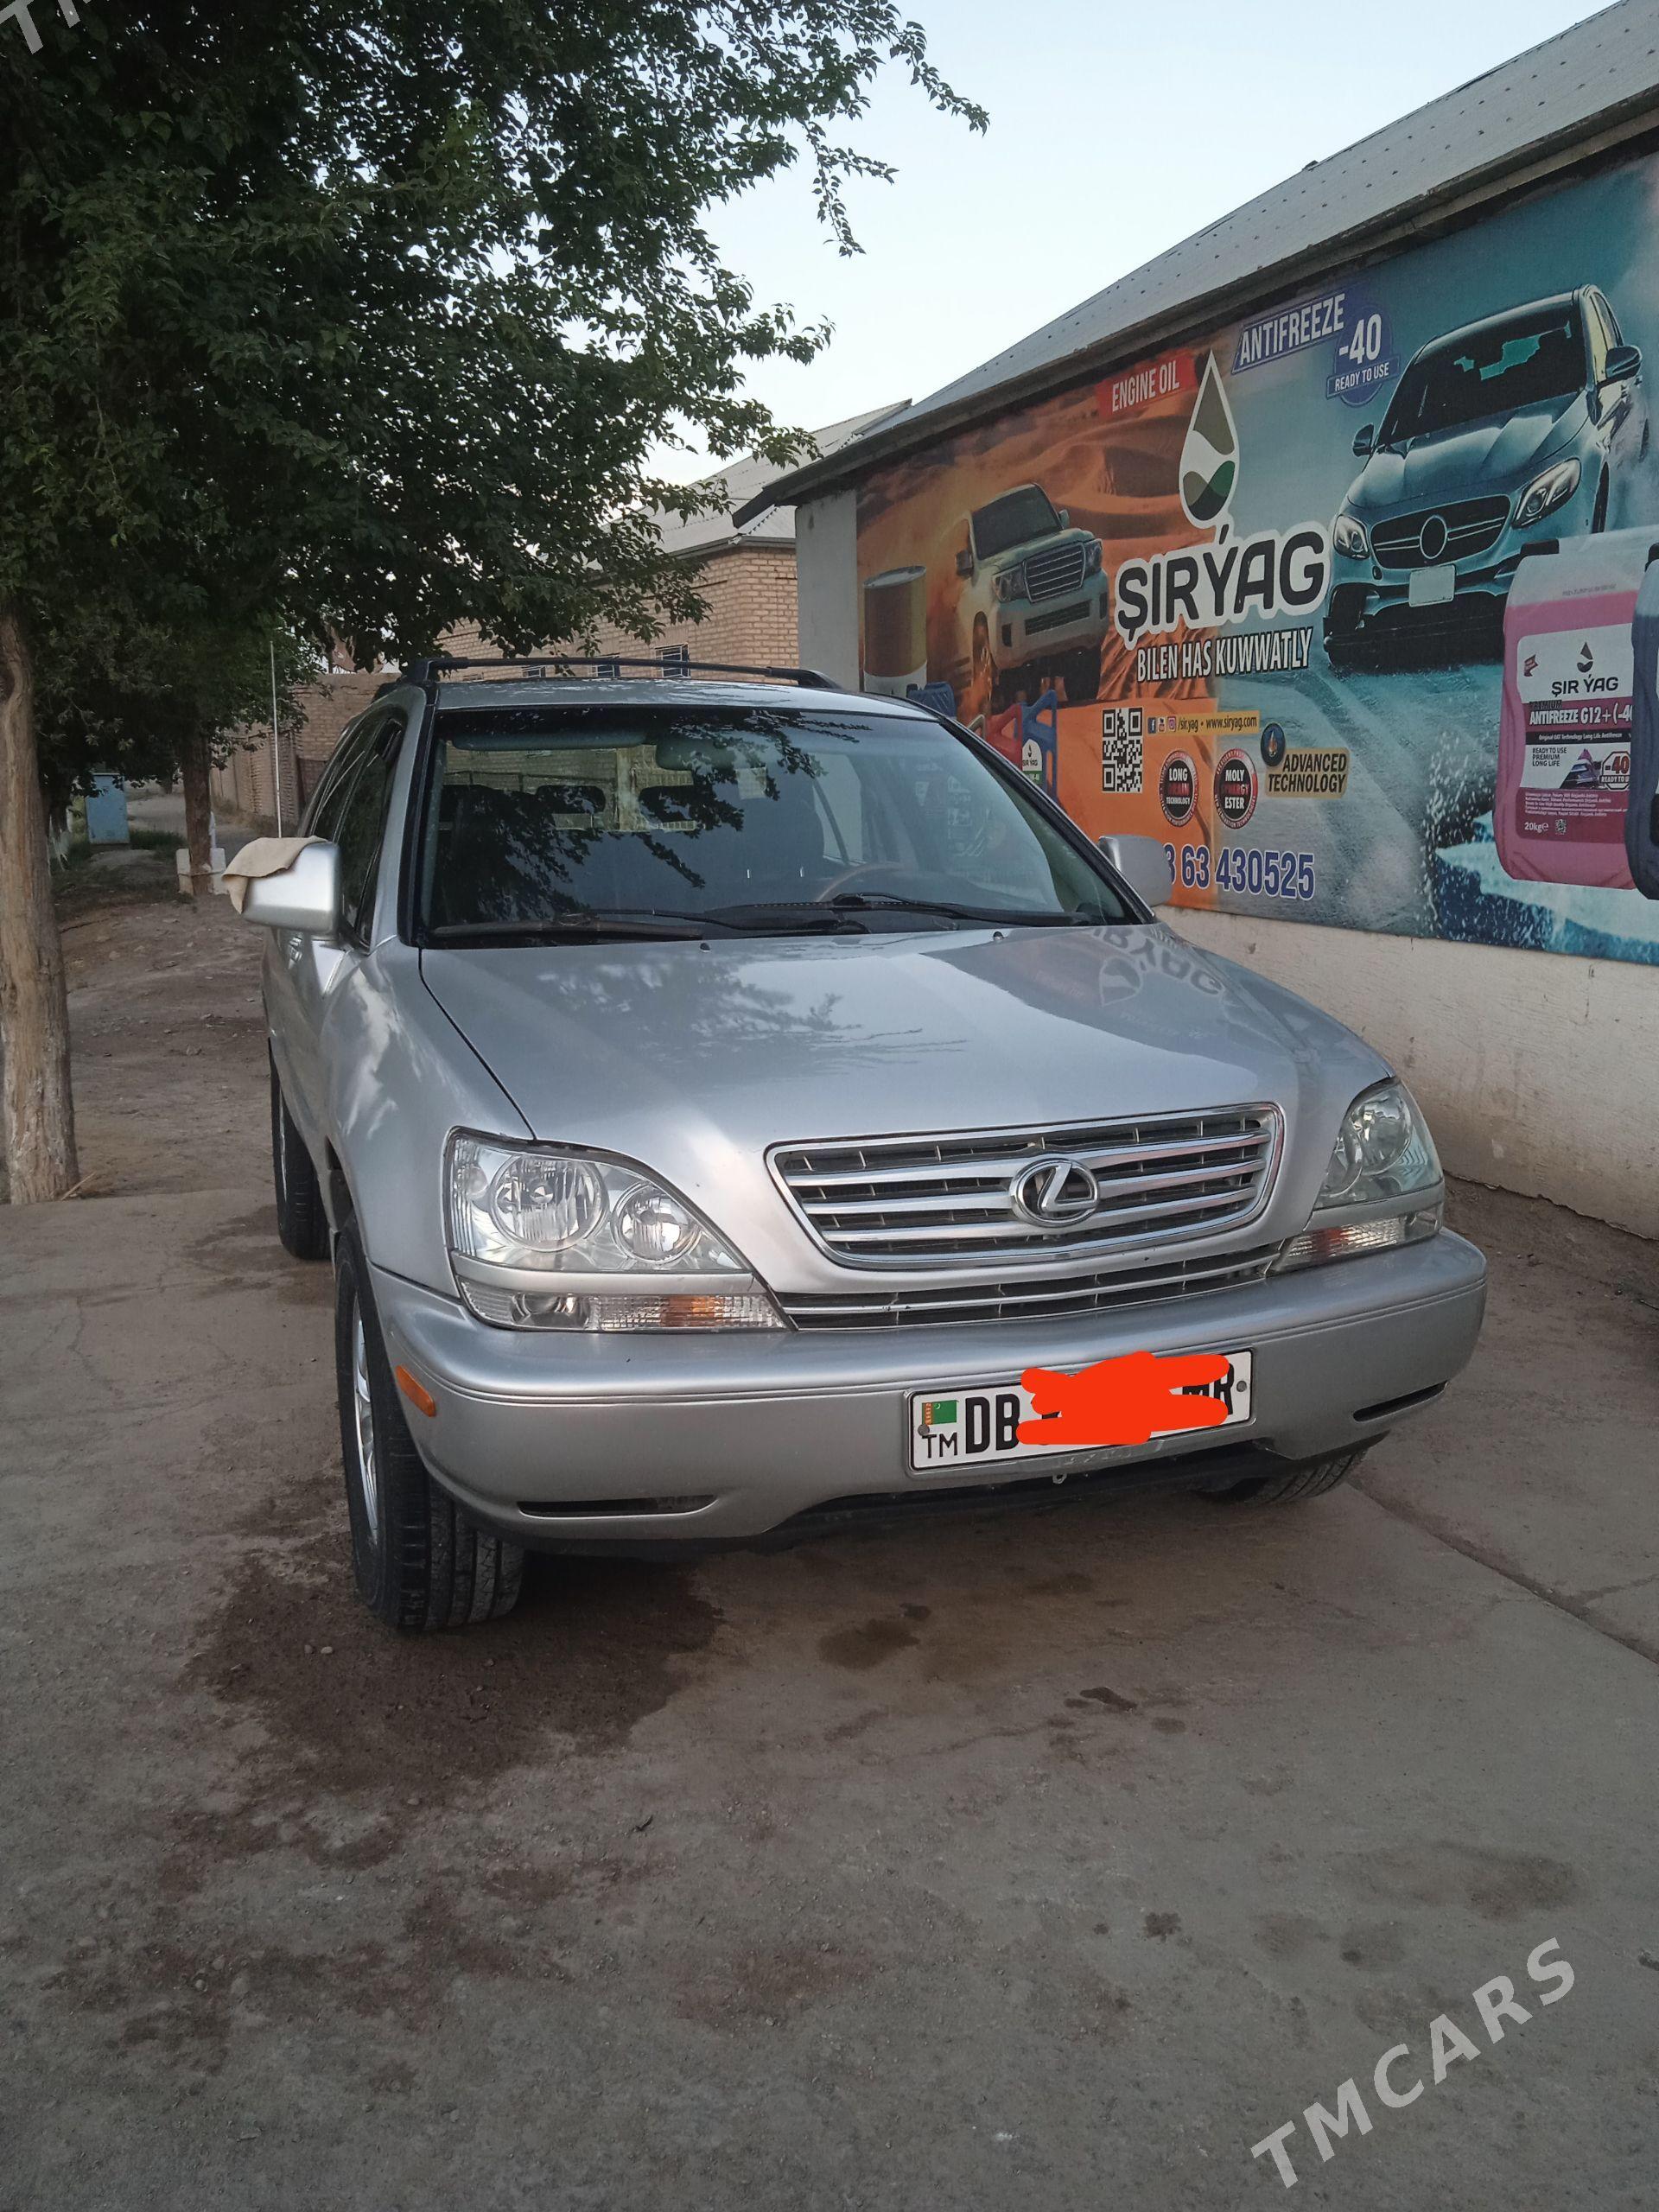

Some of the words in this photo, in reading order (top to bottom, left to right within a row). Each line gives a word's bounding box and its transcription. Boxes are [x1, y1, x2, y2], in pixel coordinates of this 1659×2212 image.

[1239, 293, 1345, 366] ANTIFREEZE
[1338, 314, 1382, 365] -40
[1111, 365, 1156, 413] ENGINE
[1159, 359, 1180, 392] OIL
[1334, 372, 1362, 392] READY
[1362, 367, 1372, 384] TO
[1373, 362, 1389, 379] USE
[1137, 645, 1178, 683] BILEN
[1182, 640, 1212, 677] HAS
[1215, 628, 1314, 675] KUWWATLY
[1583, 674, 1618, 693] ÝAG
[1205, 715, 1257, 732] www.siryag.com
[1529, 709, 1579, 725] ANTIFREEZE
[1580, 706, 1611, 724] G12+
[1282, 753, 1348, 772] ADVANCED
[1605, 755, 1630, 774] -40
[1169, 767, 1188, 782] LONG
[1224, 769, 1245, 782] MOLY
[1268, 773, 1347, 793] TECHNOLOGY
[1166, 797, 1191, 805] TECHNOLOGY
[1224, 797, 1245, 810] ESTER
[1181, 843, 1210, 889] 63
[1215, 847, 1315, 900] 430525
[965, 1393, 1021, 1455] DB
[921, 1432, 959, 1459] TM
